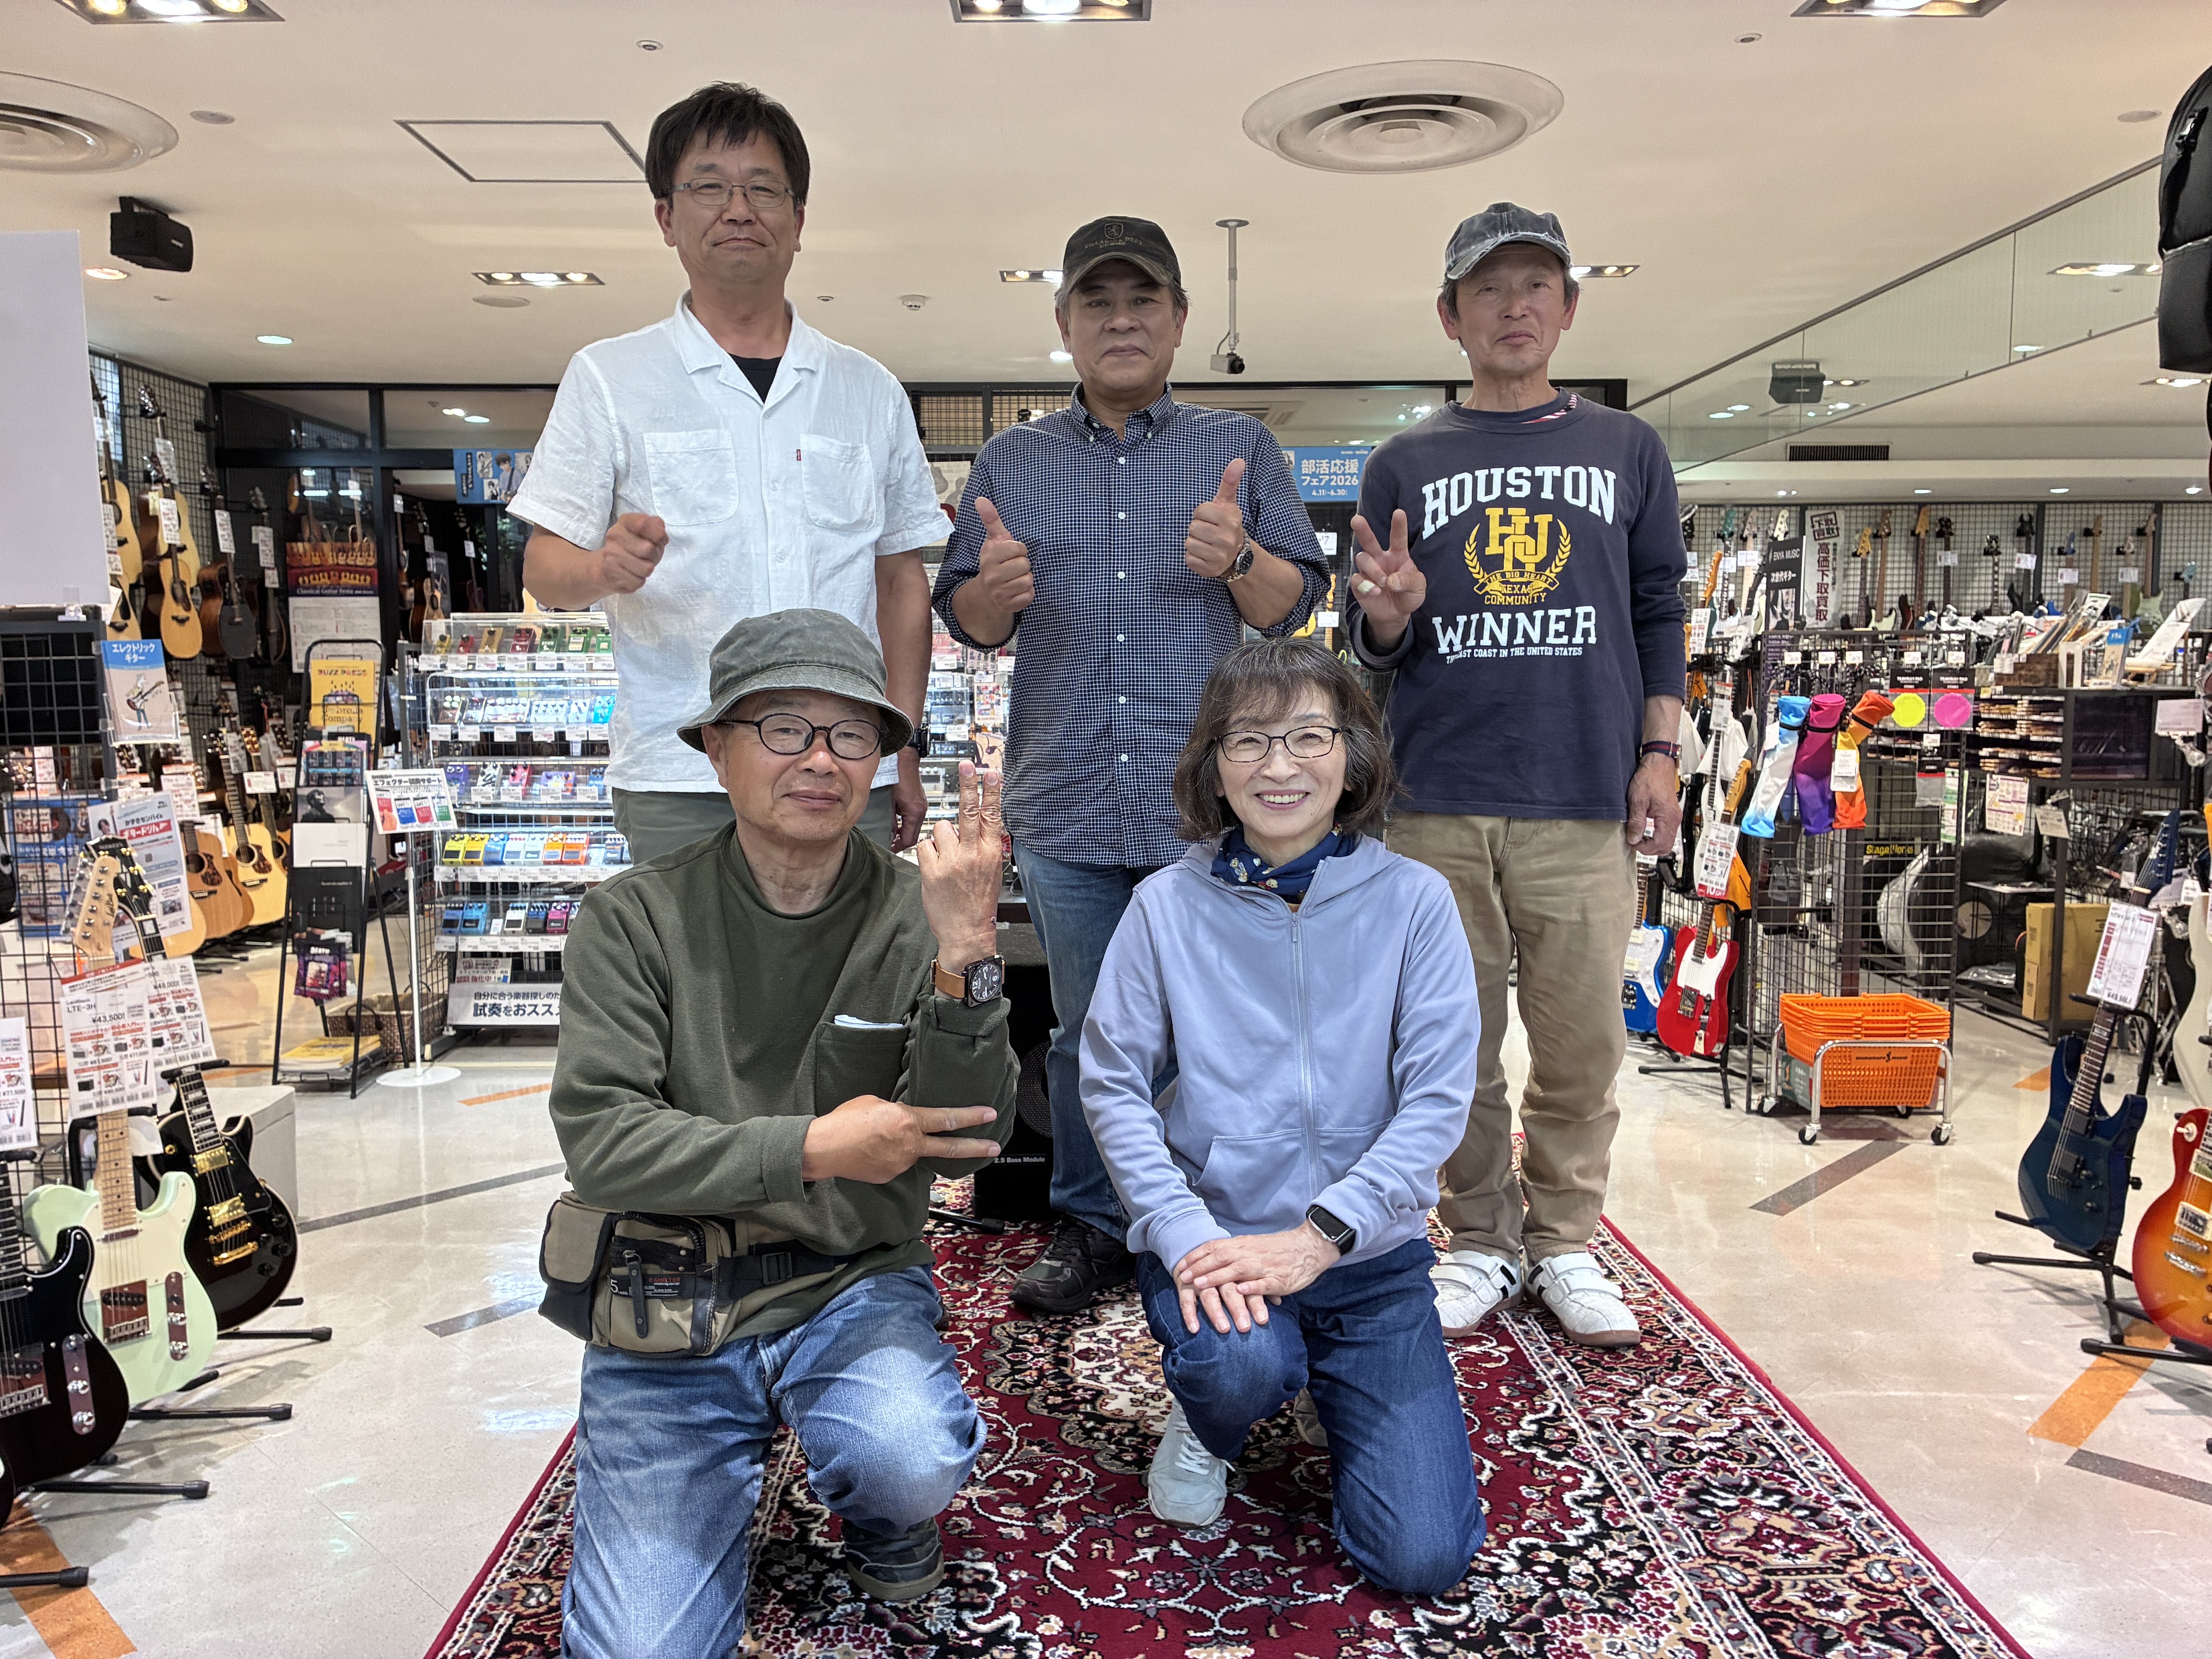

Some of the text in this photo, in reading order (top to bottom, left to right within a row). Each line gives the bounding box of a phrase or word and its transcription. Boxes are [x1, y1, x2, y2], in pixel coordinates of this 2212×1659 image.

[1301, 459, 1359, 474] 部活応援
[1300, 475, 1359, 486] フェア2026
[1422, 466, 1617, 540] HOUSTON
[1483, 572, 1503, 586] THE
[1524, 571, 1553, 585] HEART
[1816, 542, 1830, 621] 高価下取買取
[1499, 583, 1533, 594] TEXAS
[1484, 592, 1547, 605] COMMUNITY
[1432, 605, 1597, 654] WINNER
[112, 643, 156, 653] エレクトリック
[1473, 648, 1498, 658] COAST
[1499, 649, 1508, 658] IN
[1510, 647, 1525, 657] THE
[1527, 647, 1553, 656] UNITED
[1554, 647, 1583, 656] STATES
[125, 653, 146, 663] ギター
[972, 980, 978, 990] 12
[67, 1004, 96, 1013] LTE-3H
[473, 1003, 560, 1017] 試奏をおスス
[610, 1279, 618, 1293] 5
